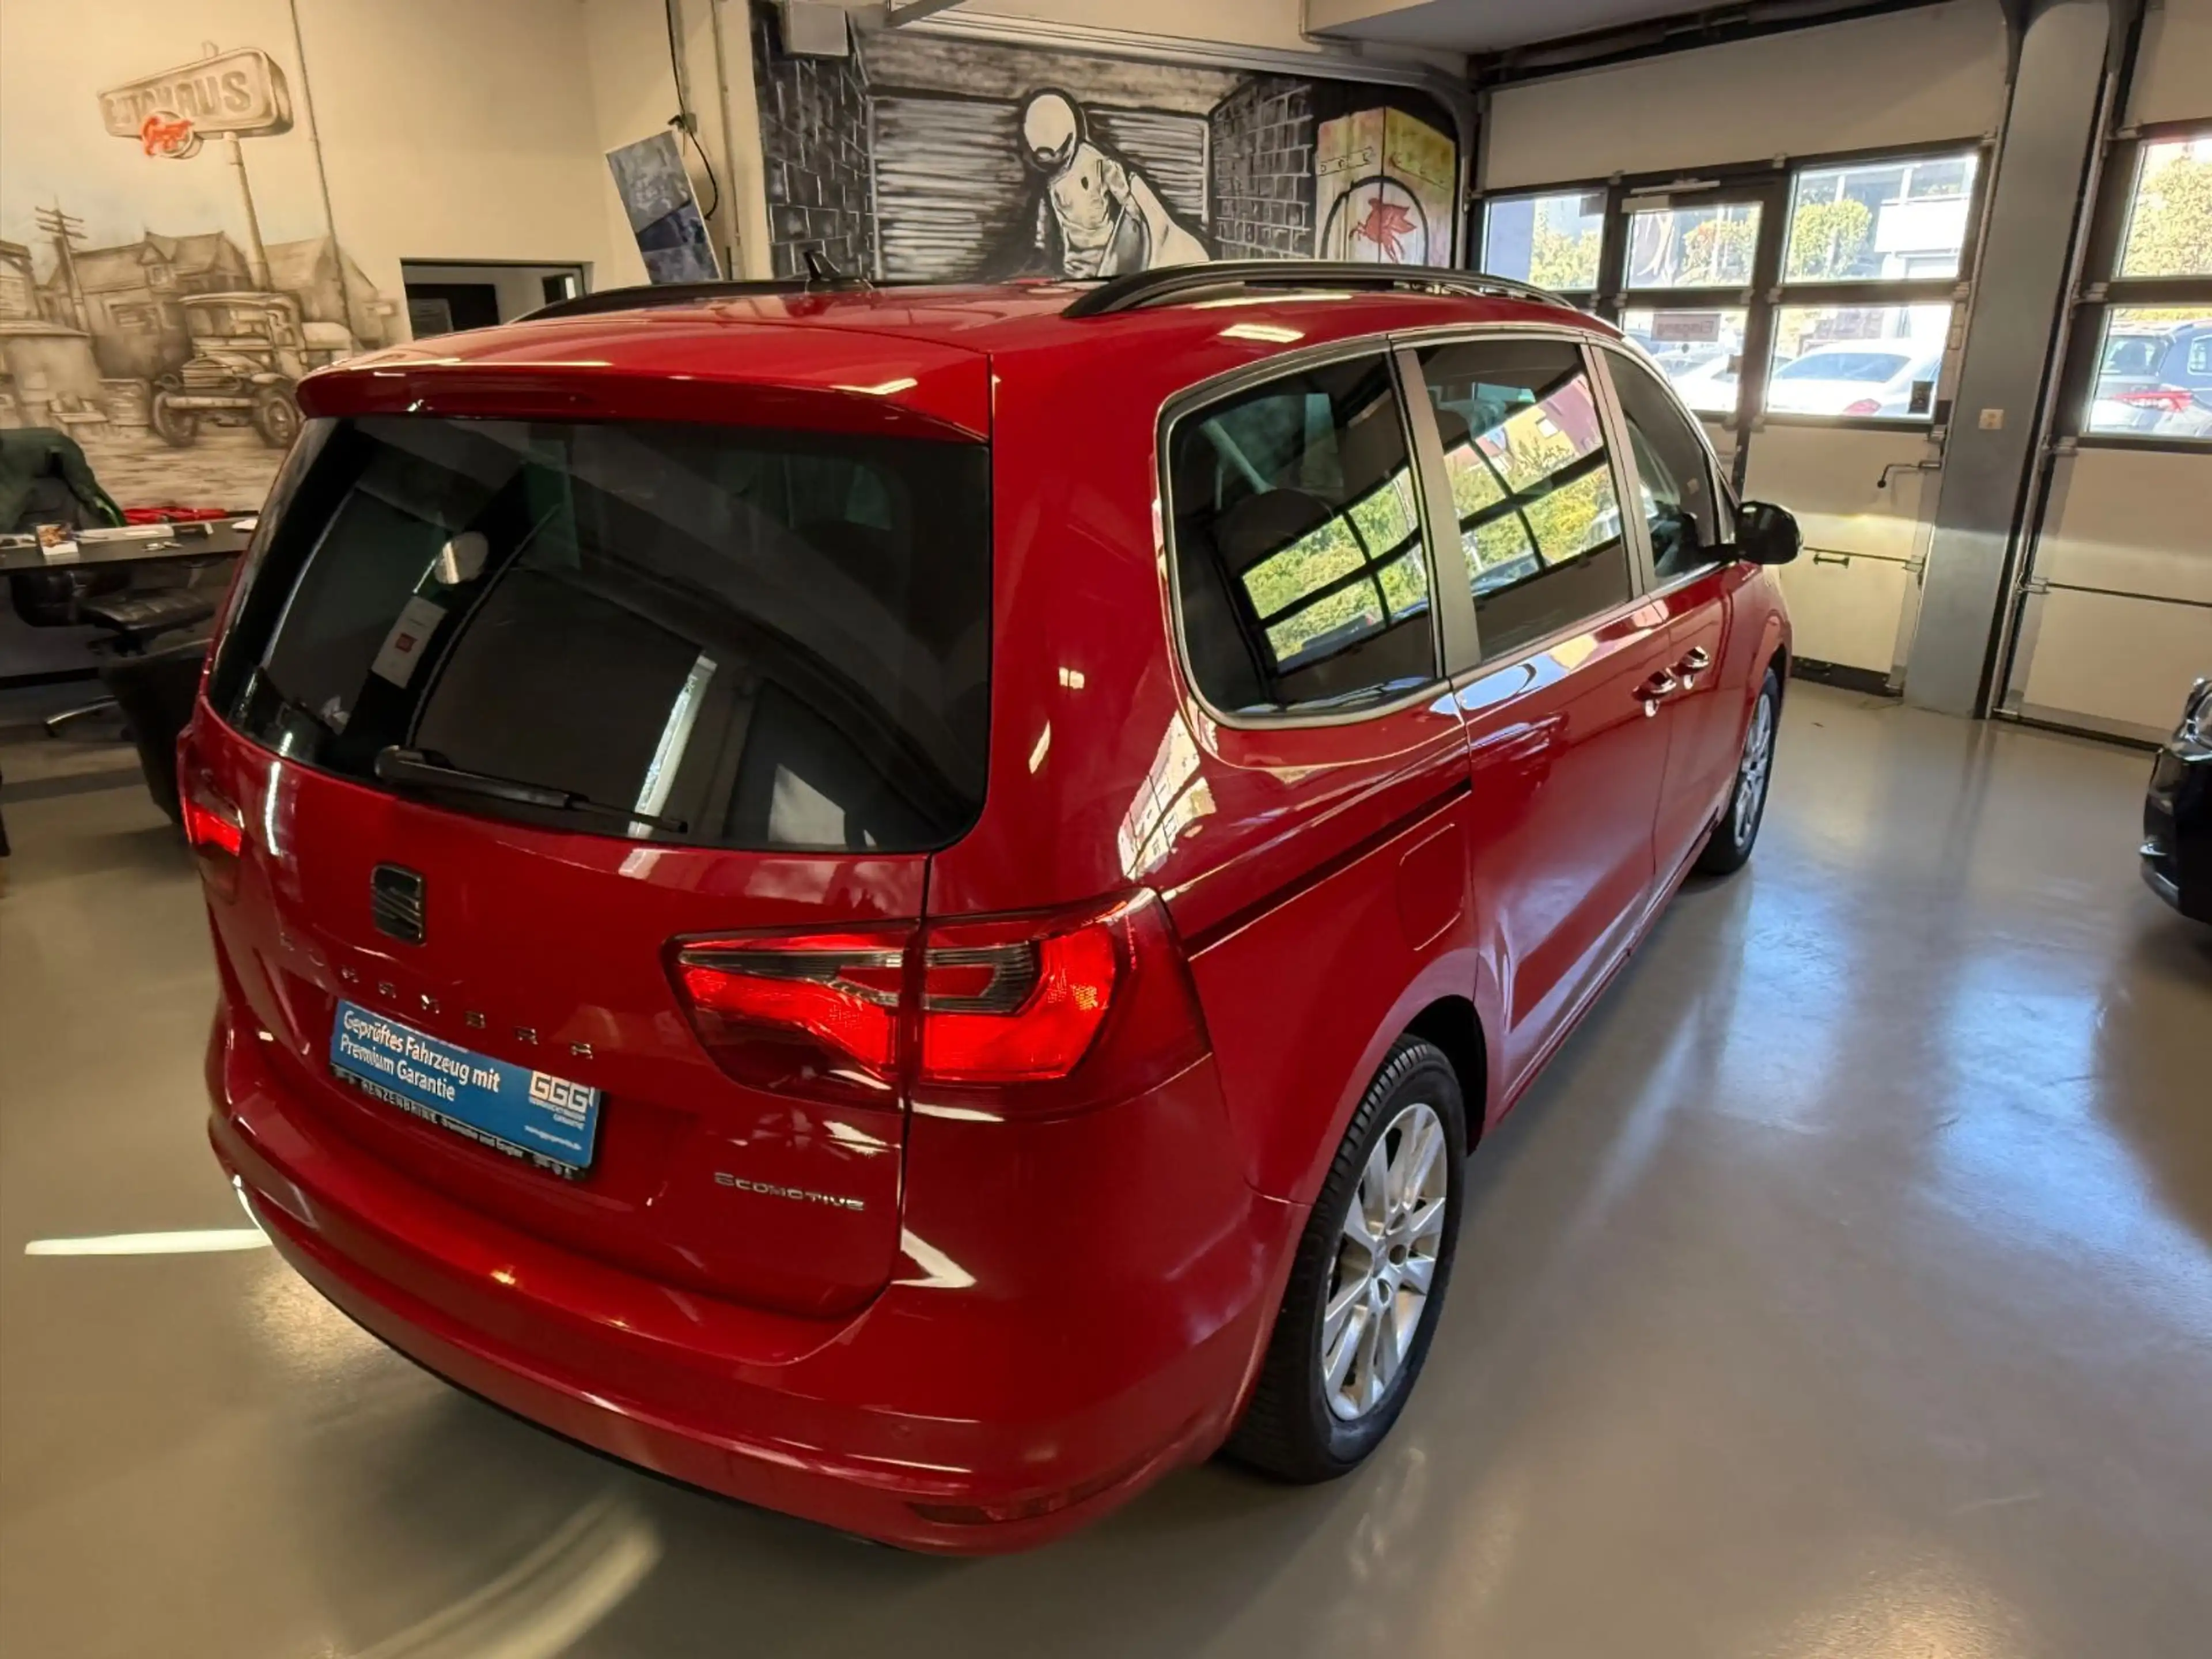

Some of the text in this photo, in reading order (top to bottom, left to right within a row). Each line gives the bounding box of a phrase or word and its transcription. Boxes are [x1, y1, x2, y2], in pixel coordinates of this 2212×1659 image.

[340, 1033, 395, 1075] Premium
[396, 1060, 456, 1102] Garantie
[343, 1010, 403, 1053] Geprüftes
[405, 1035, 469, 1086] Fahrzeug
[472, 1067, 501, 1093] mit
